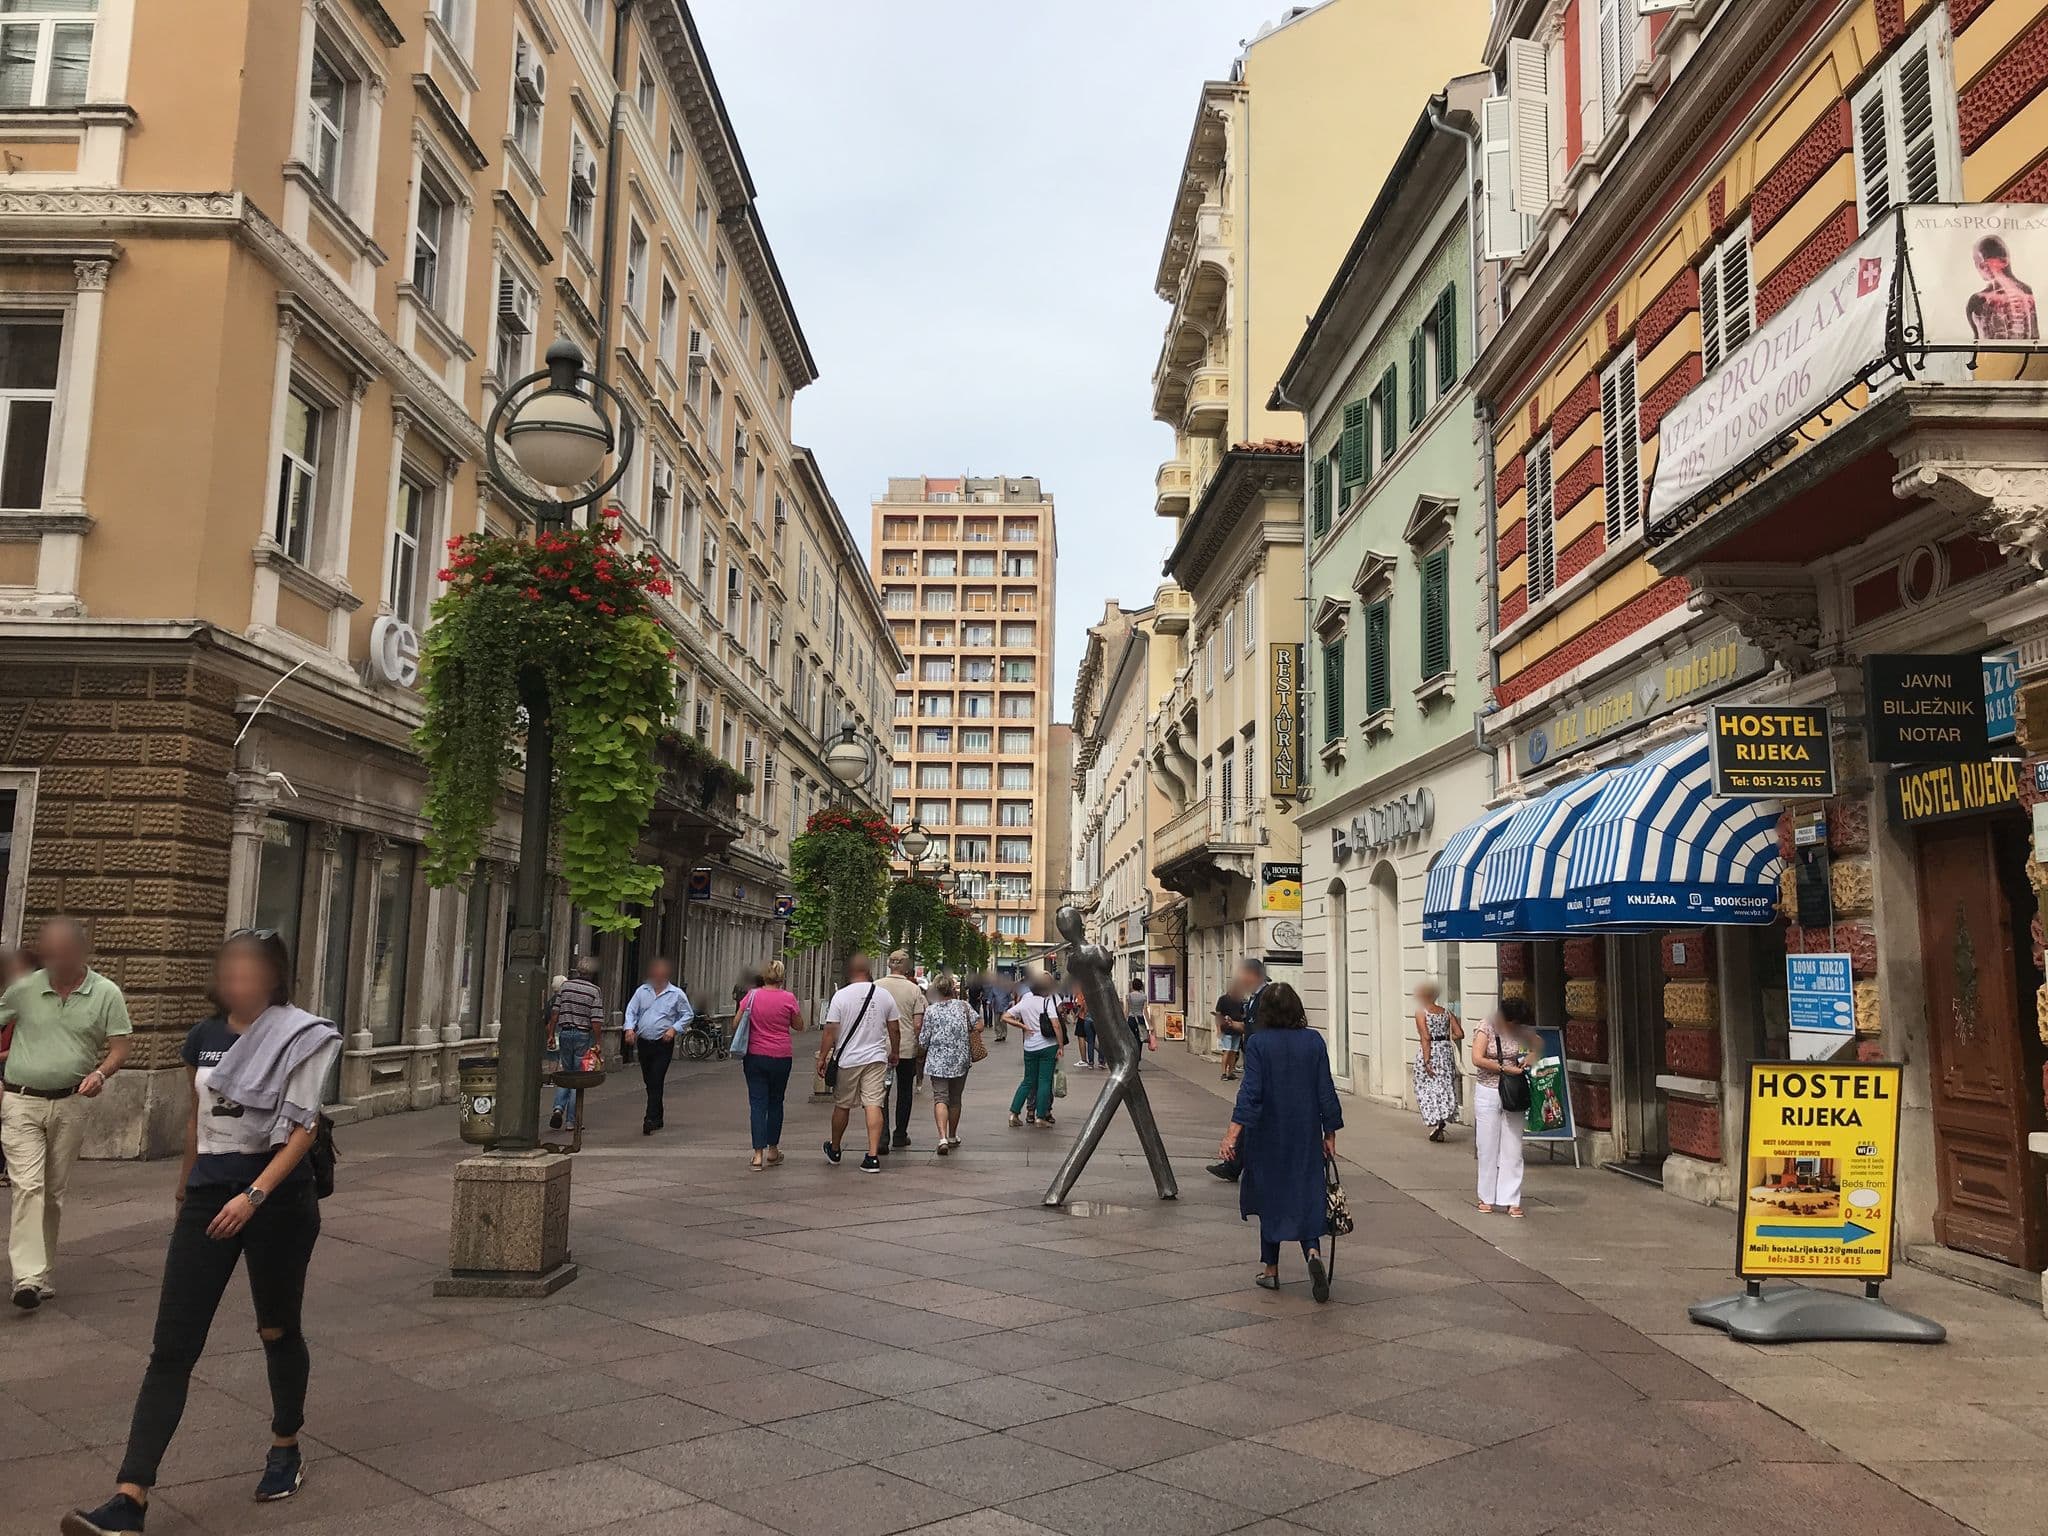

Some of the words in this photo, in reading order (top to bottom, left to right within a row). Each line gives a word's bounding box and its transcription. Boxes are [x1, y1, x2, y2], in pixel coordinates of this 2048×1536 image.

[1723, 415, 1741, 457] 19
[1747, 393, 1768, 438] 88
[1775, 356, 1811, 417] 606
[1902, 674, 1952, 688] JAVNI
[1883, 698, 1975, 715] BILJEŽNIK
[1275, 649, 1293, 790] RESTAURANT
[1720, 715, 1823, 737] HOSTEL
[1900, 728, 1961, 742] NOTAR
[1736, 743, 1810, 761] RIJEKA
[1730, 776, 1749, 787] Tel:
[1752, 776, 1798, 787] 051-215
[1800, 777, 1822, 787] 415
[1900, 767, 1960, 820] HOSTEL
[1960, 761, 2019, 809] RIJEKA
[1627, 892, 1676, 905] KNJIŽARA
[1714, 896, 1769, 907] BOOKSHOP
[1758, 1073, 1889, 1099] HOSTEL
[1781, 1106, 1862, 1127] RIJEKA
[1842, 1180, 1864, 1188] Beds
[1845, 1208, 1853, 1219] 0
[1865, 1208, 1881, 1219] 24
[1749, 1244, 1769, 1252] Mail:
[1808, 1255, 1819, 1263] 51
[1823, 1256, 1841, 1264] 215
[1843, 1256, 1861, 1265] 415
